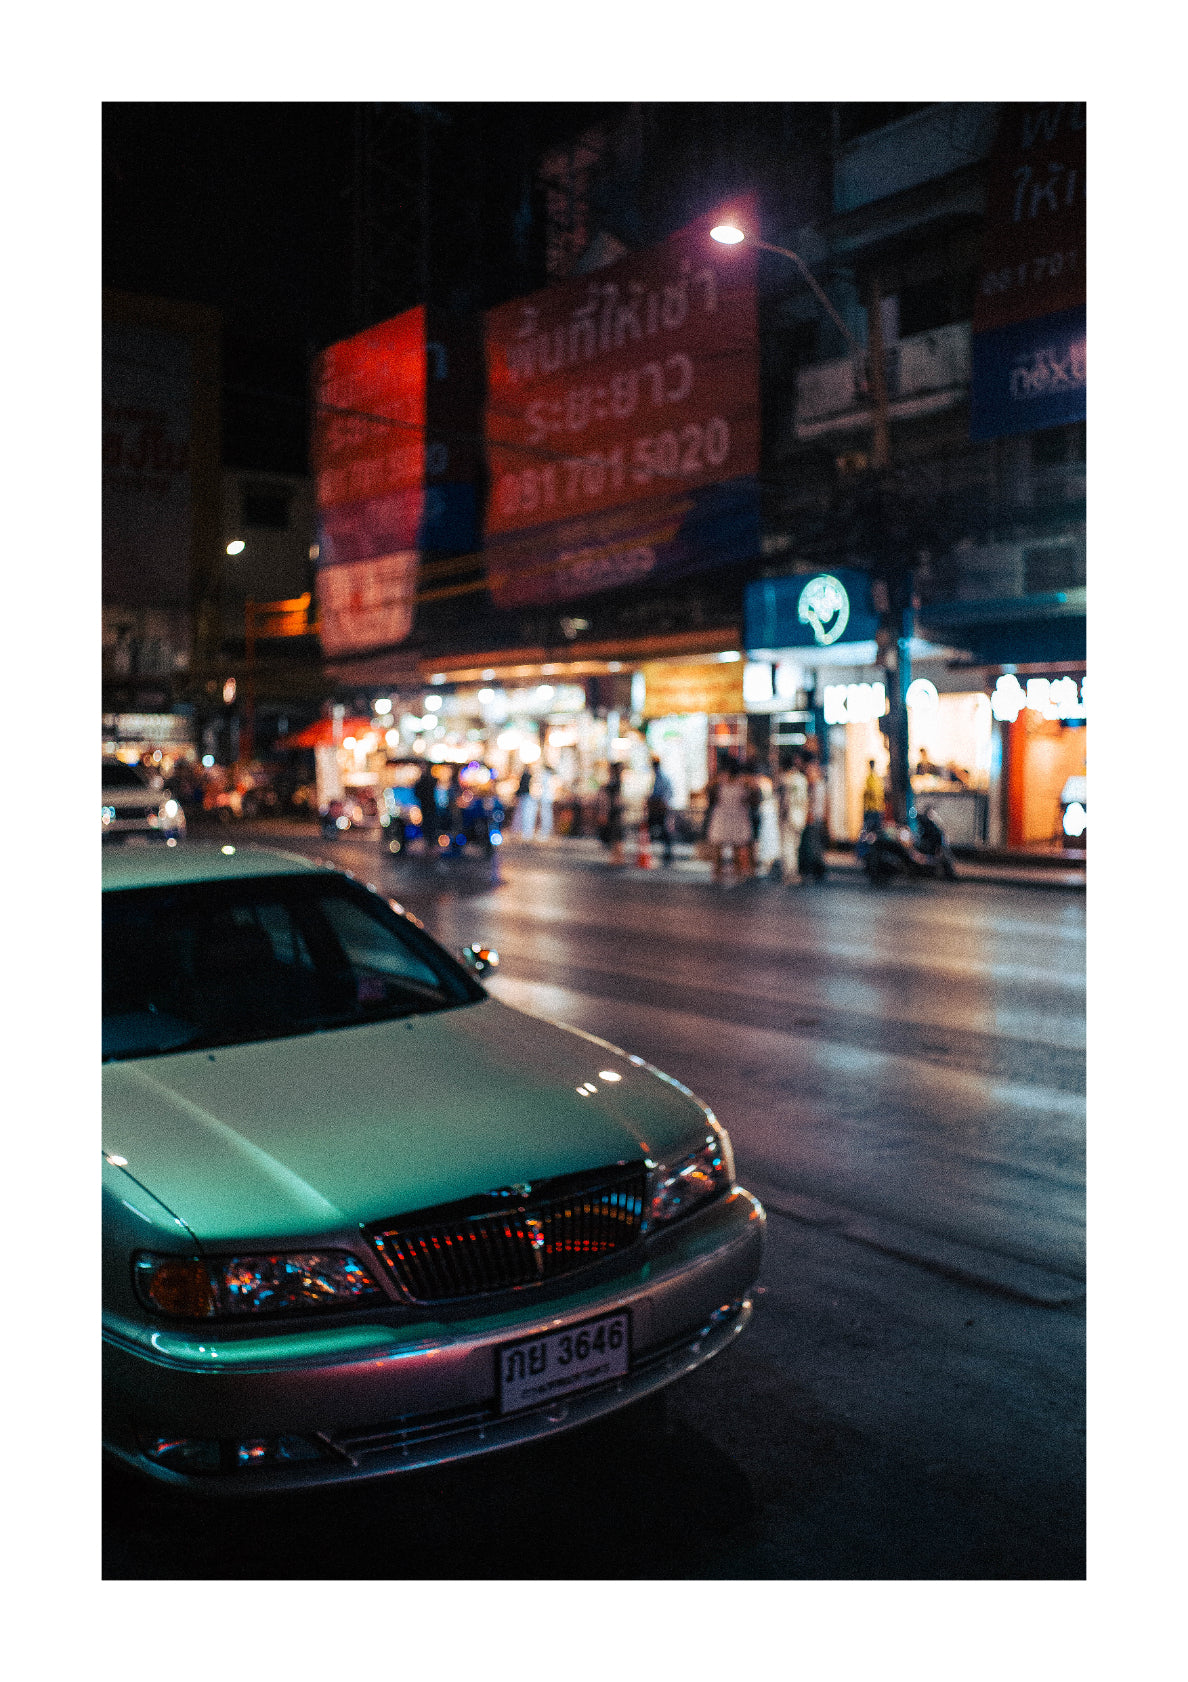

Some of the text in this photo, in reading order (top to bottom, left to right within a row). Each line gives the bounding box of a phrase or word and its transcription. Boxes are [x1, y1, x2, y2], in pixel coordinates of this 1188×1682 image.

[525, 352, 694, 445] ระยะยาว
[562, 446, 625, 502] 701
[631, 416, 731, 486] 5020
[505, 1343, 547, 1384] ภย
[558, 1320, 623, 1366] 3646
